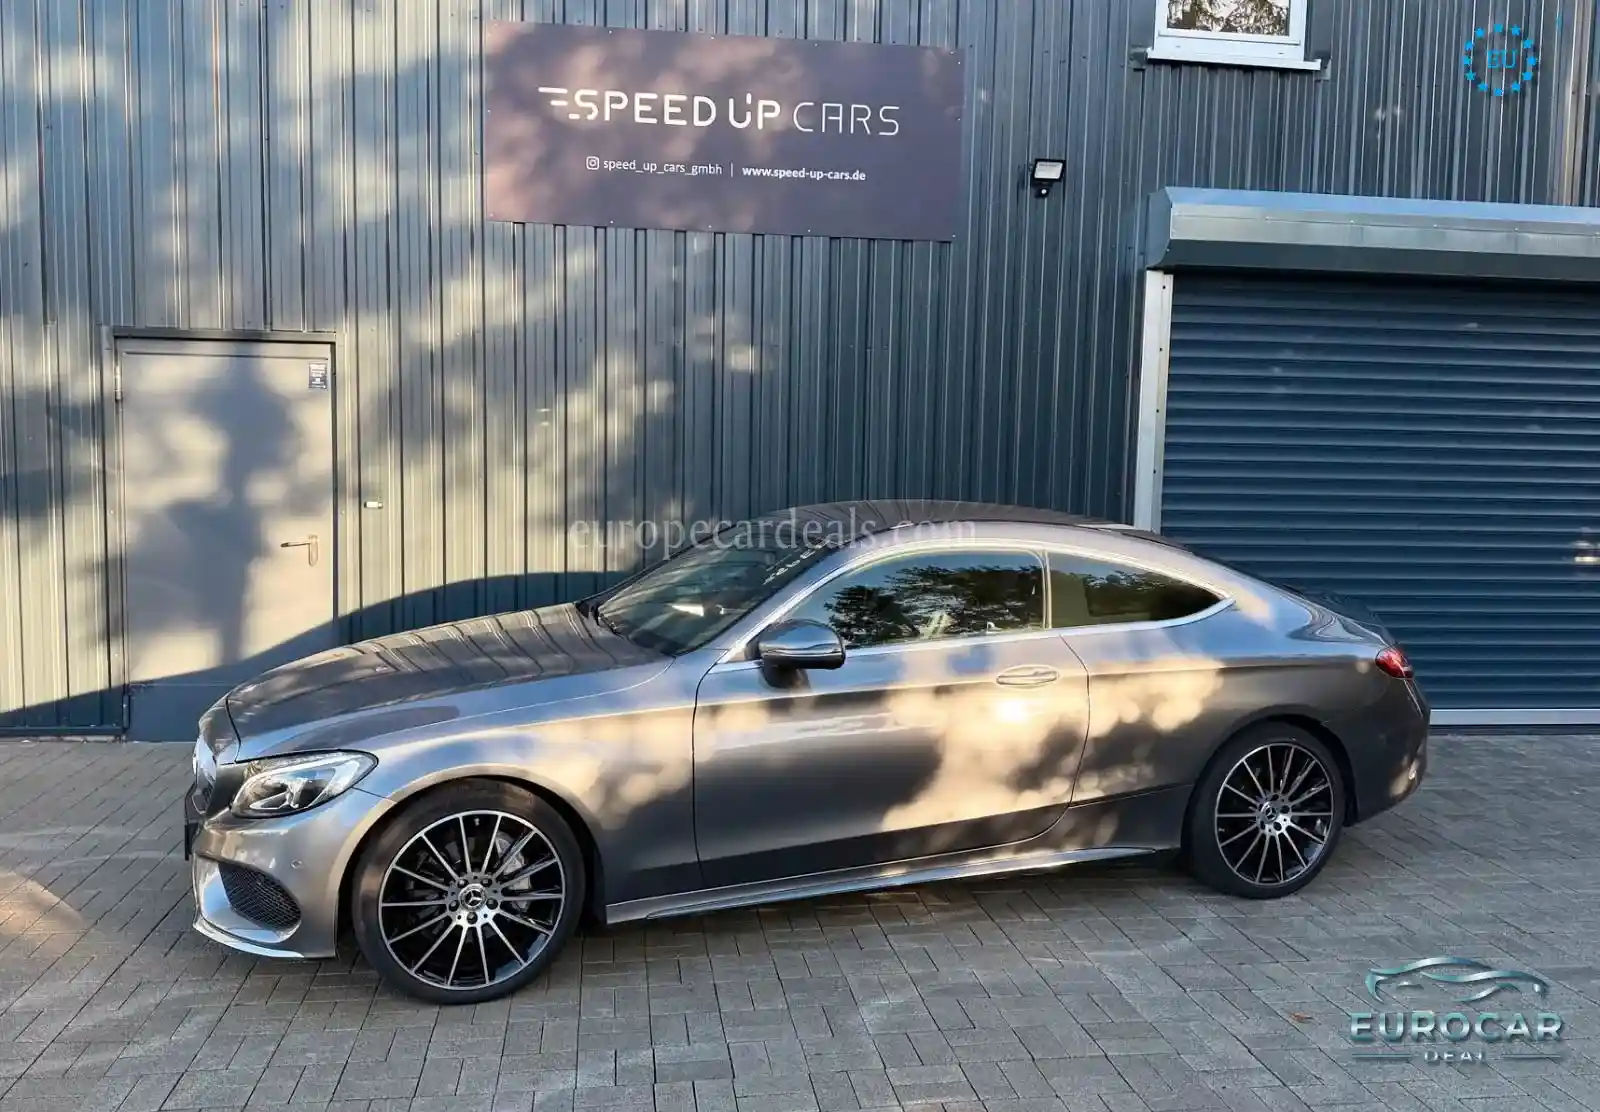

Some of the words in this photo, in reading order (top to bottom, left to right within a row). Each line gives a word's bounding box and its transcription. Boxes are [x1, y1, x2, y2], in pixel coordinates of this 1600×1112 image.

[569, 88, 717, 127] SPEED
[729, 93, 781, 131] UP
[793, 102, 900, 136] CARS
[603, 159, 723, 177] speed_up_cars_gmbh
[742, 167, 866, 181] www.speed-up-cars.de
